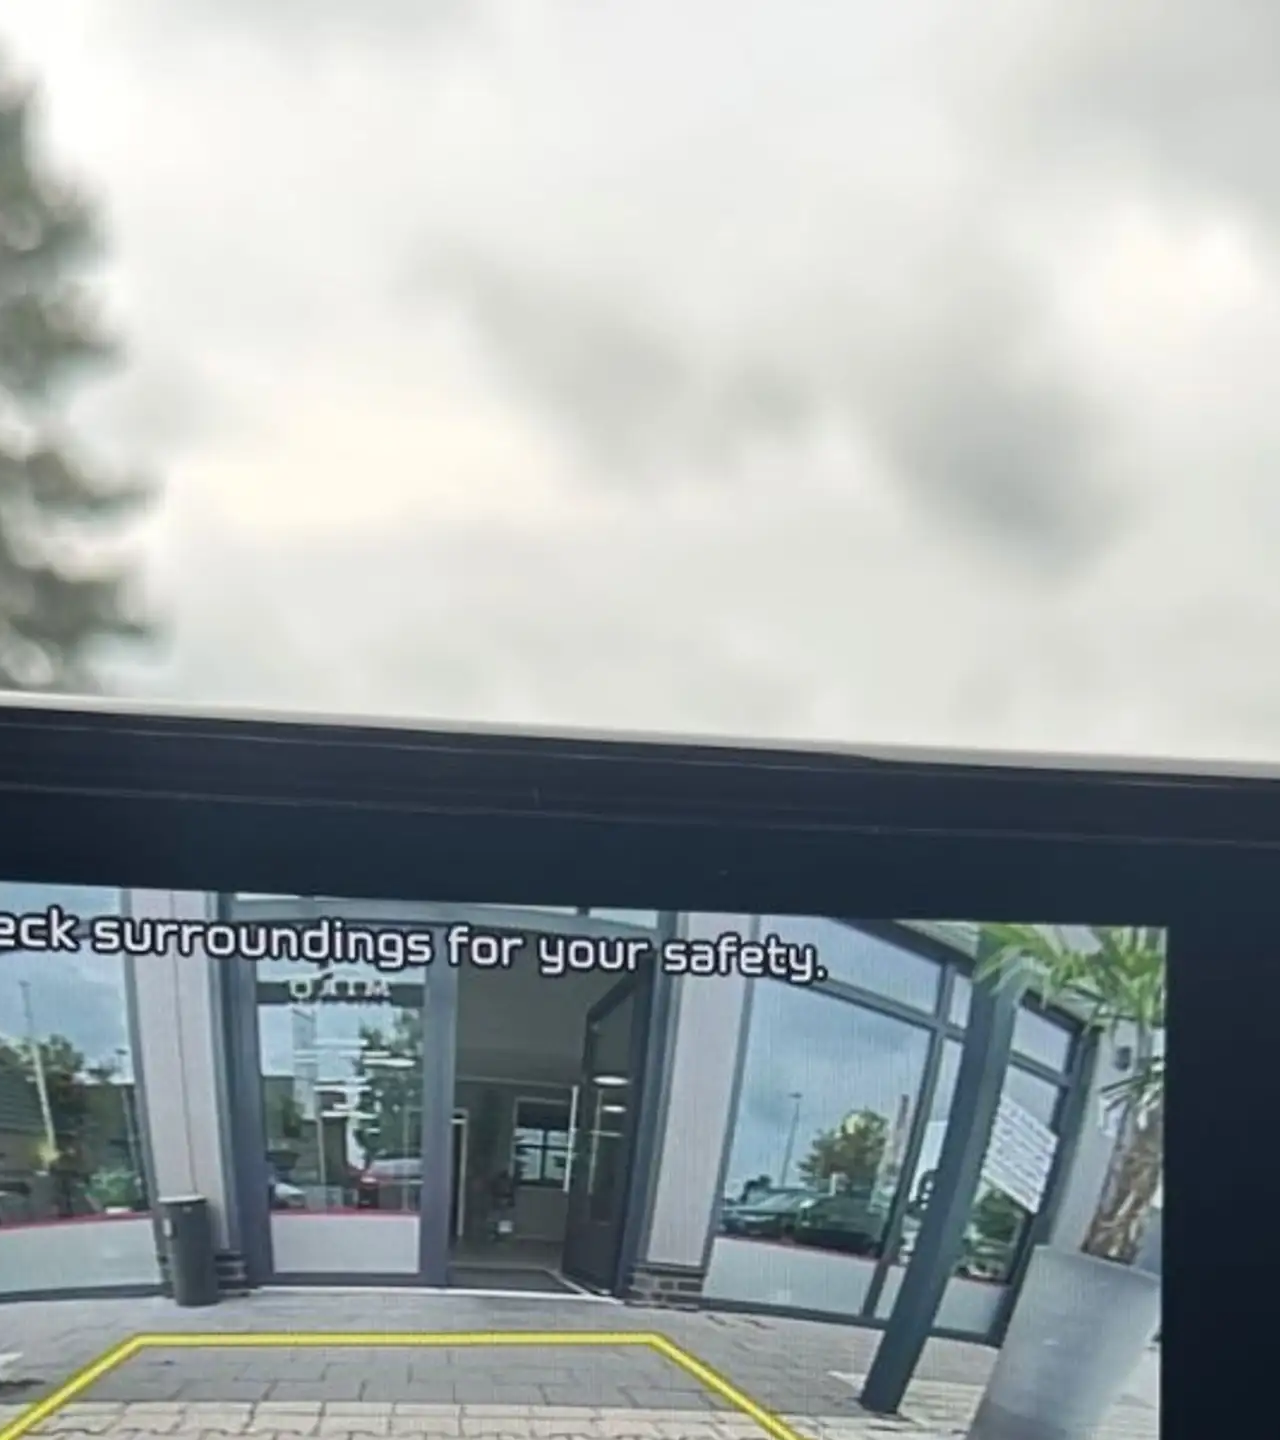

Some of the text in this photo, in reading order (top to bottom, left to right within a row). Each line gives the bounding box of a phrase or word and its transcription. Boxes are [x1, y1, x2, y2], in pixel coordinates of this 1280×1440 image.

[93, 918, 433, 969] surroundings
[448, 924, 525, 967] for
[540, 936, 650, 975] your
[664, 934, 829, 982] safety.
